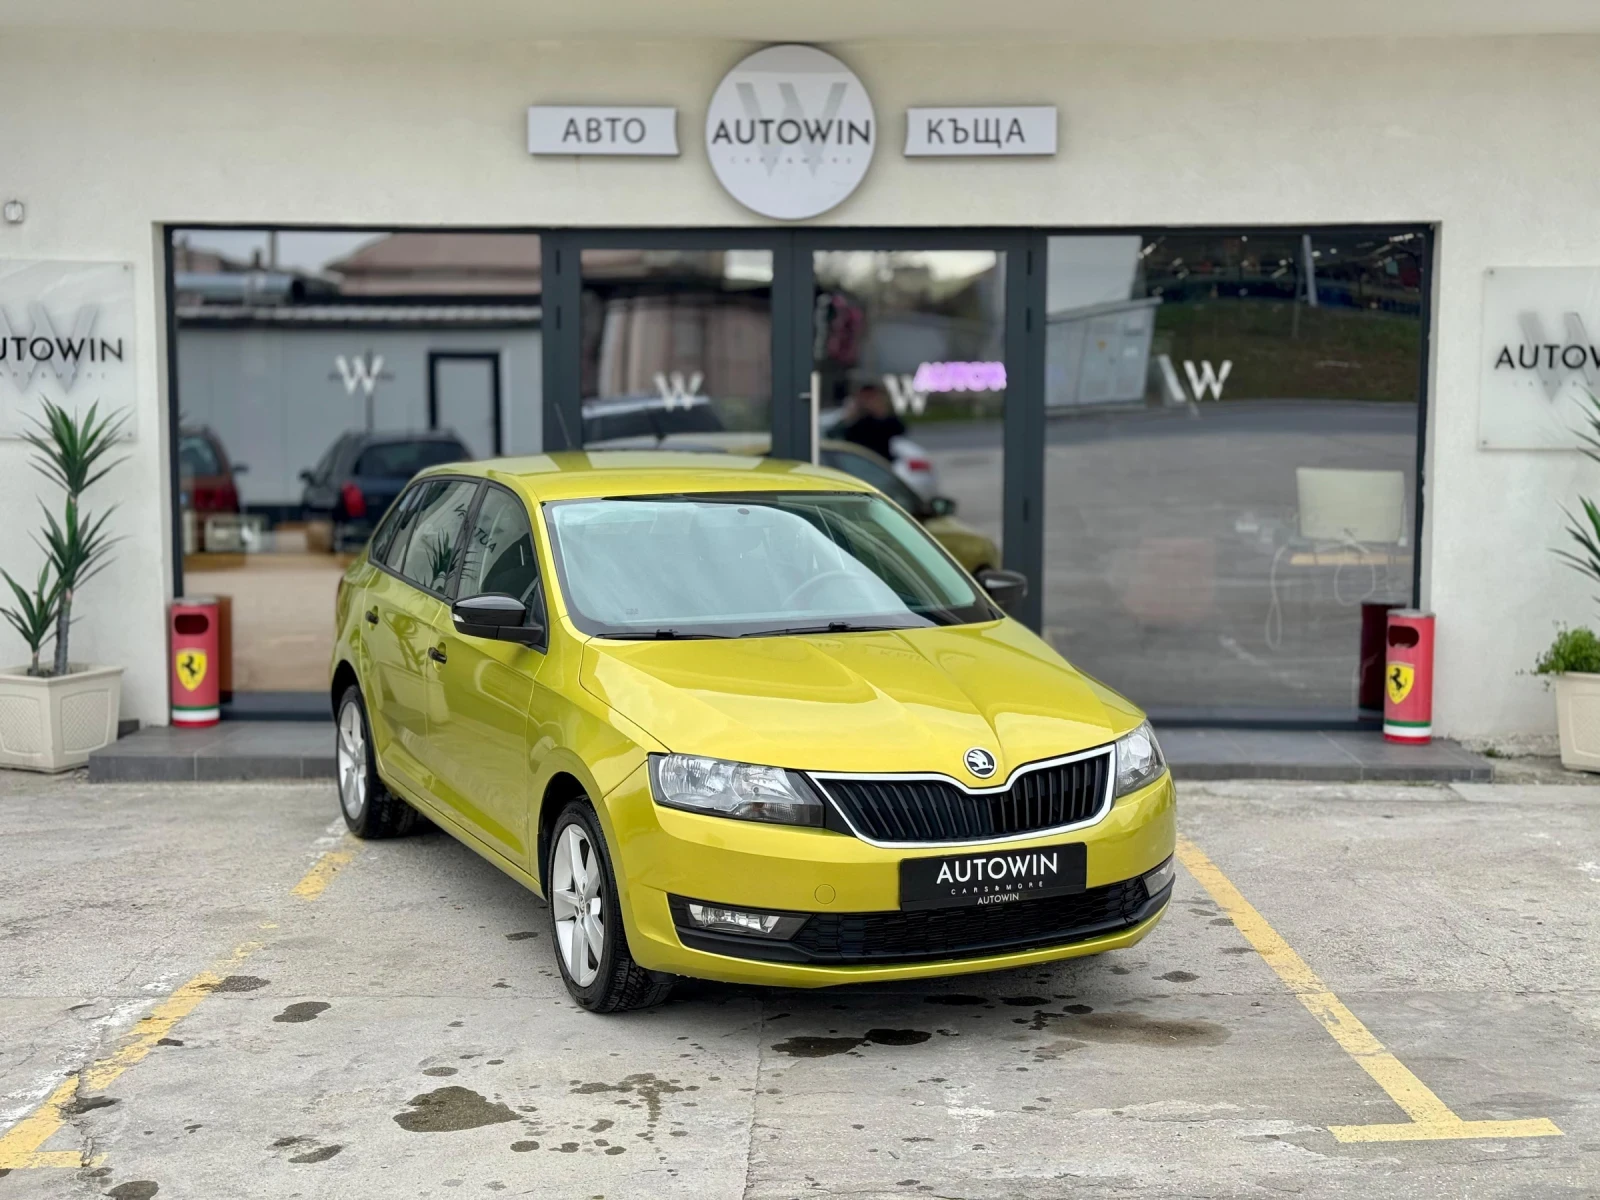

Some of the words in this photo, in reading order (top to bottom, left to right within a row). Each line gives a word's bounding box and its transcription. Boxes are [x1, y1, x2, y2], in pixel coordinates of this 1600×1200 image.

[562, 117, 646, 143] АВТО
[711, 119, 870, 145] AUTOWIN
[927, 117, 1026, 148] КЪЩА
[936, 852, 1058, 884] AUTOWIN
[951, 881, 1043, 895] CARS&MORE
[977, 893, 1019, 905] AUTOWIN
